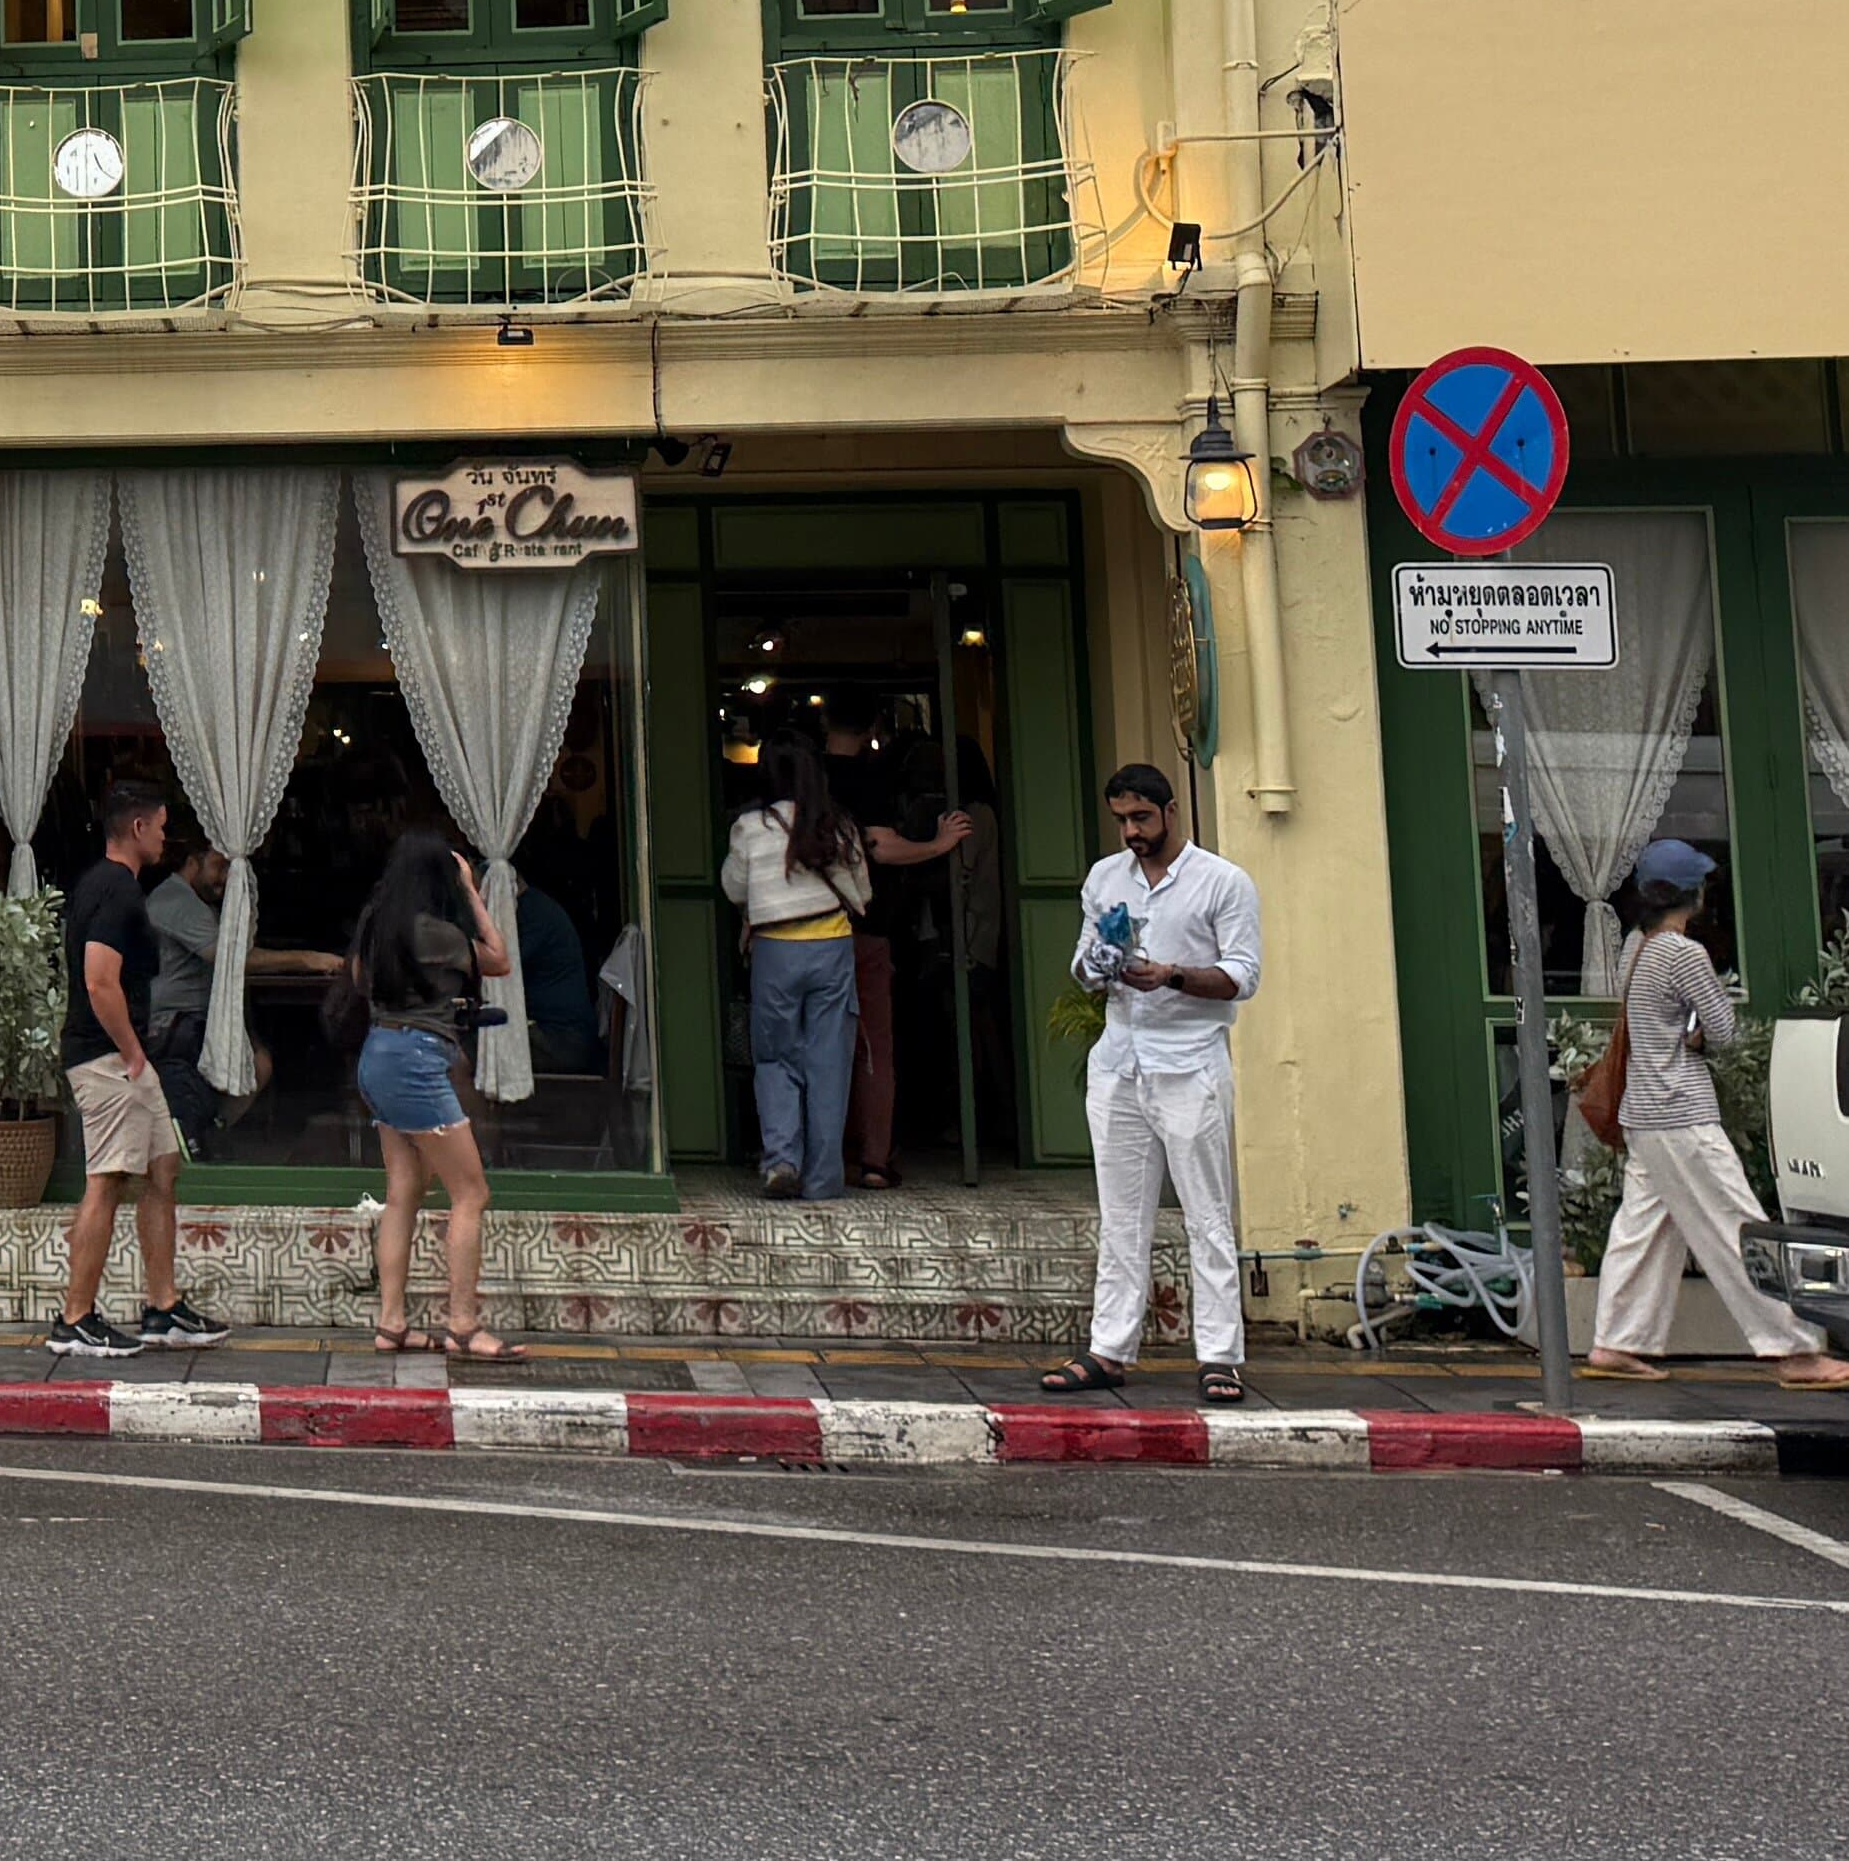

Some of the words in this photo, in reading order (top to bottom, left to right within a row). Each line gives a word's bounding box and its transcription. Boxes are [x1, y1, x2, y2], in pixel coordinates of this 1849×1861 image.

[466, 466, 493, 485] วัน
[502, 465, 558, 485] จันทร์
[477, 492, 507, 515] 1st
[504, 485, 630, 541] Chun
[504, 542, 583, 557] Rstarant
[1408, 573, 1600, 617] ห้ามหยุดตลอดเวลา
[1430, 619, 1450, 635] NO
[1455, 619, 1520, 635] STOPPING
[1526, 619, 1583, 635] ANYTIME
